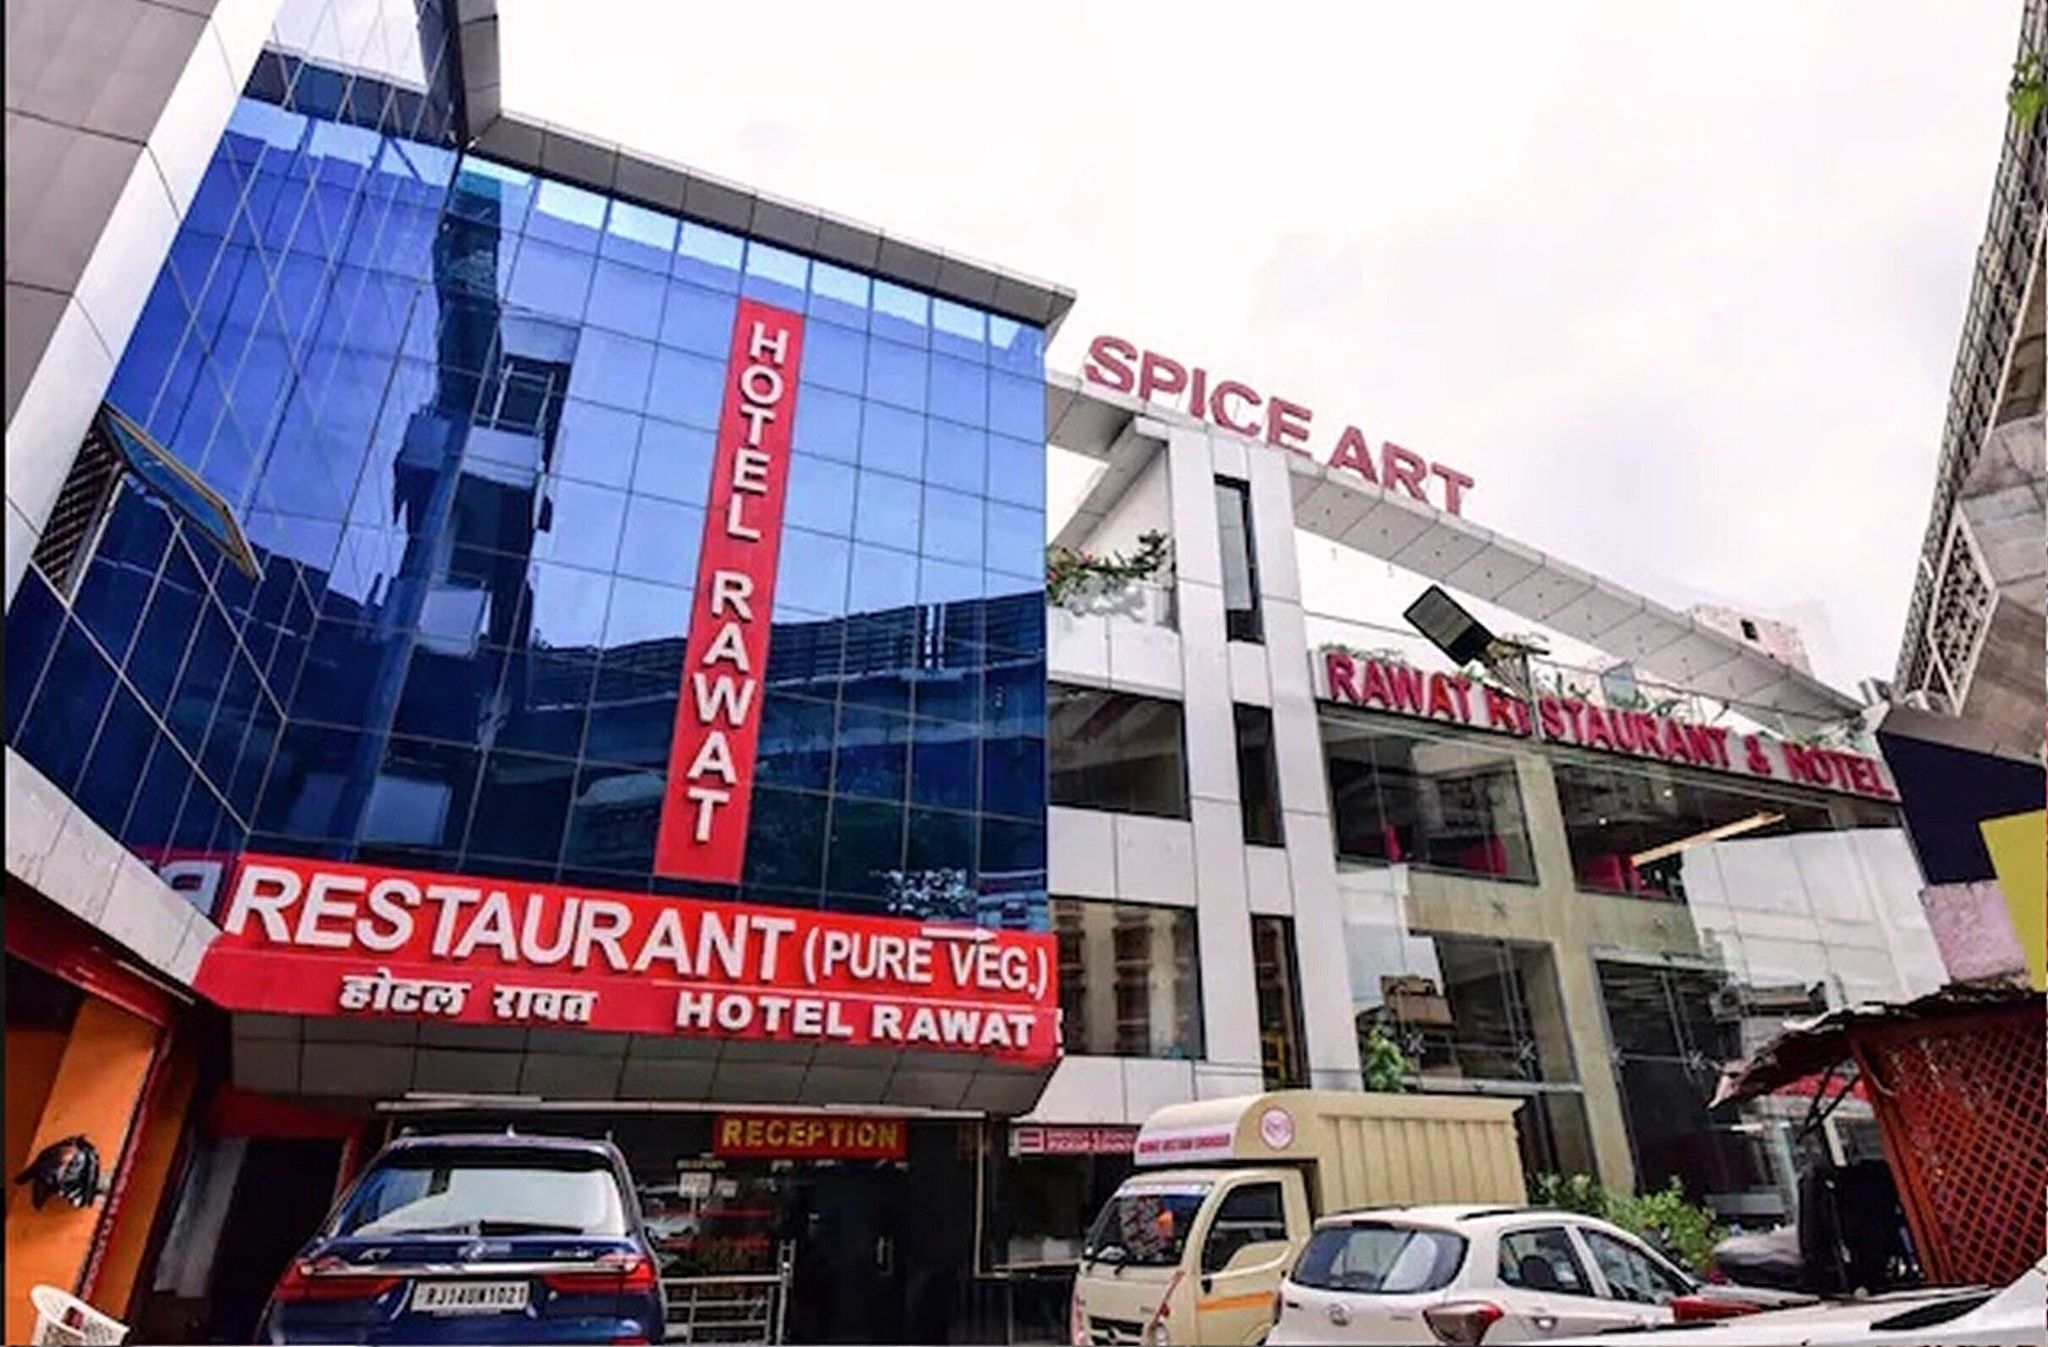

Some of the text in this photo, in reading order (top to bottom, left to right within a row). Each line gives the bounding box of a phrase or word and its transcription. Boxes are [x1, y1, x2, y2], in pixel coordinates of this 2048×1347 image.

[1083, 335, 1475, 516] SPICE ART
[687, 321, 788, 843] HOTEL RAWAT
[1325, 651, 1476, 726] RAWAT
[1743, 734, 1772, 776] &
[223, 864, 796, 982] RESTAURANT
[804, 926, 934, 984] (PURE
[949, 942, 1049, 1001] VEG.)
[339, 966, 600, 1024] होटल रावत
[675, 991, 854, 1038] HOTEL
[871, 1003, 1037, 1048] RAWAT
[721, 1118, 899, 1148] RECEPTION
